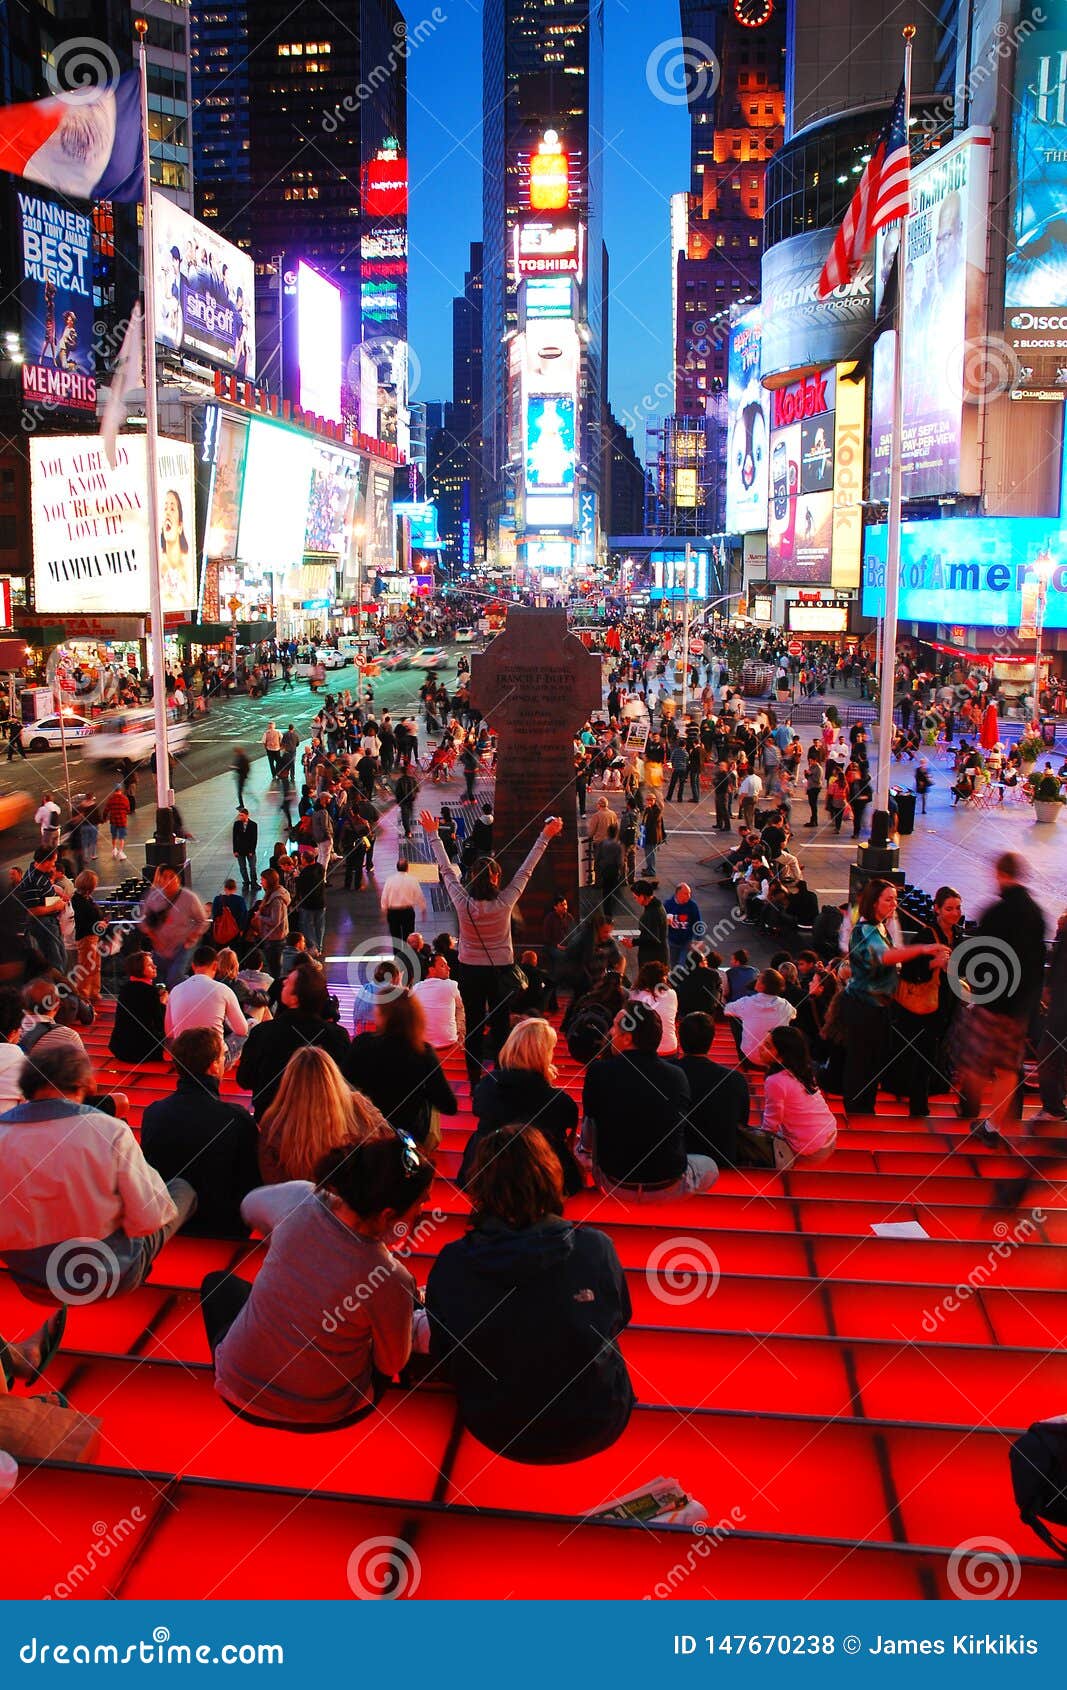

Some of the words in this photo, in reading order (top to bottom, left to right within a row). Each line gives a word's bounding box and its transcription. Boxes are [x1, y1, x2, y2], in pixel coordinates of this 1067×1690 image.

[18, 192, 91, 236] WINNER!
[23, 229, 88, 277] BEST
[519, 259, 578, 271] TOSHIBA
[24, 260, 90, 296] MUSICAL
[186, 294, 235, 336] sing-off
[816, 297, 871, 312] emotion
[1013, 340, 1019, 348] 2
[1020, 339, 1055, 348] BLOCKS
[22, 364, 97, 402] MEMPHIS
[774, 371, 828, 428] Kodak
[40, 457, 64, 478] YOU
[837, 423, 861, 529] Kodak
[68, 473, 107, 496] KNOW
[43, 498, 92, 522] YOU'RE
[95, 491, 142, 515] GONNA
[67, 518, 100, 541] LOVE
[105, 514, 124, 535] IT!
[48, 555, 102, 582] MAMMA
[105, 549, 137, 574] MIA!
[866, 556, 906, 588] Bak
